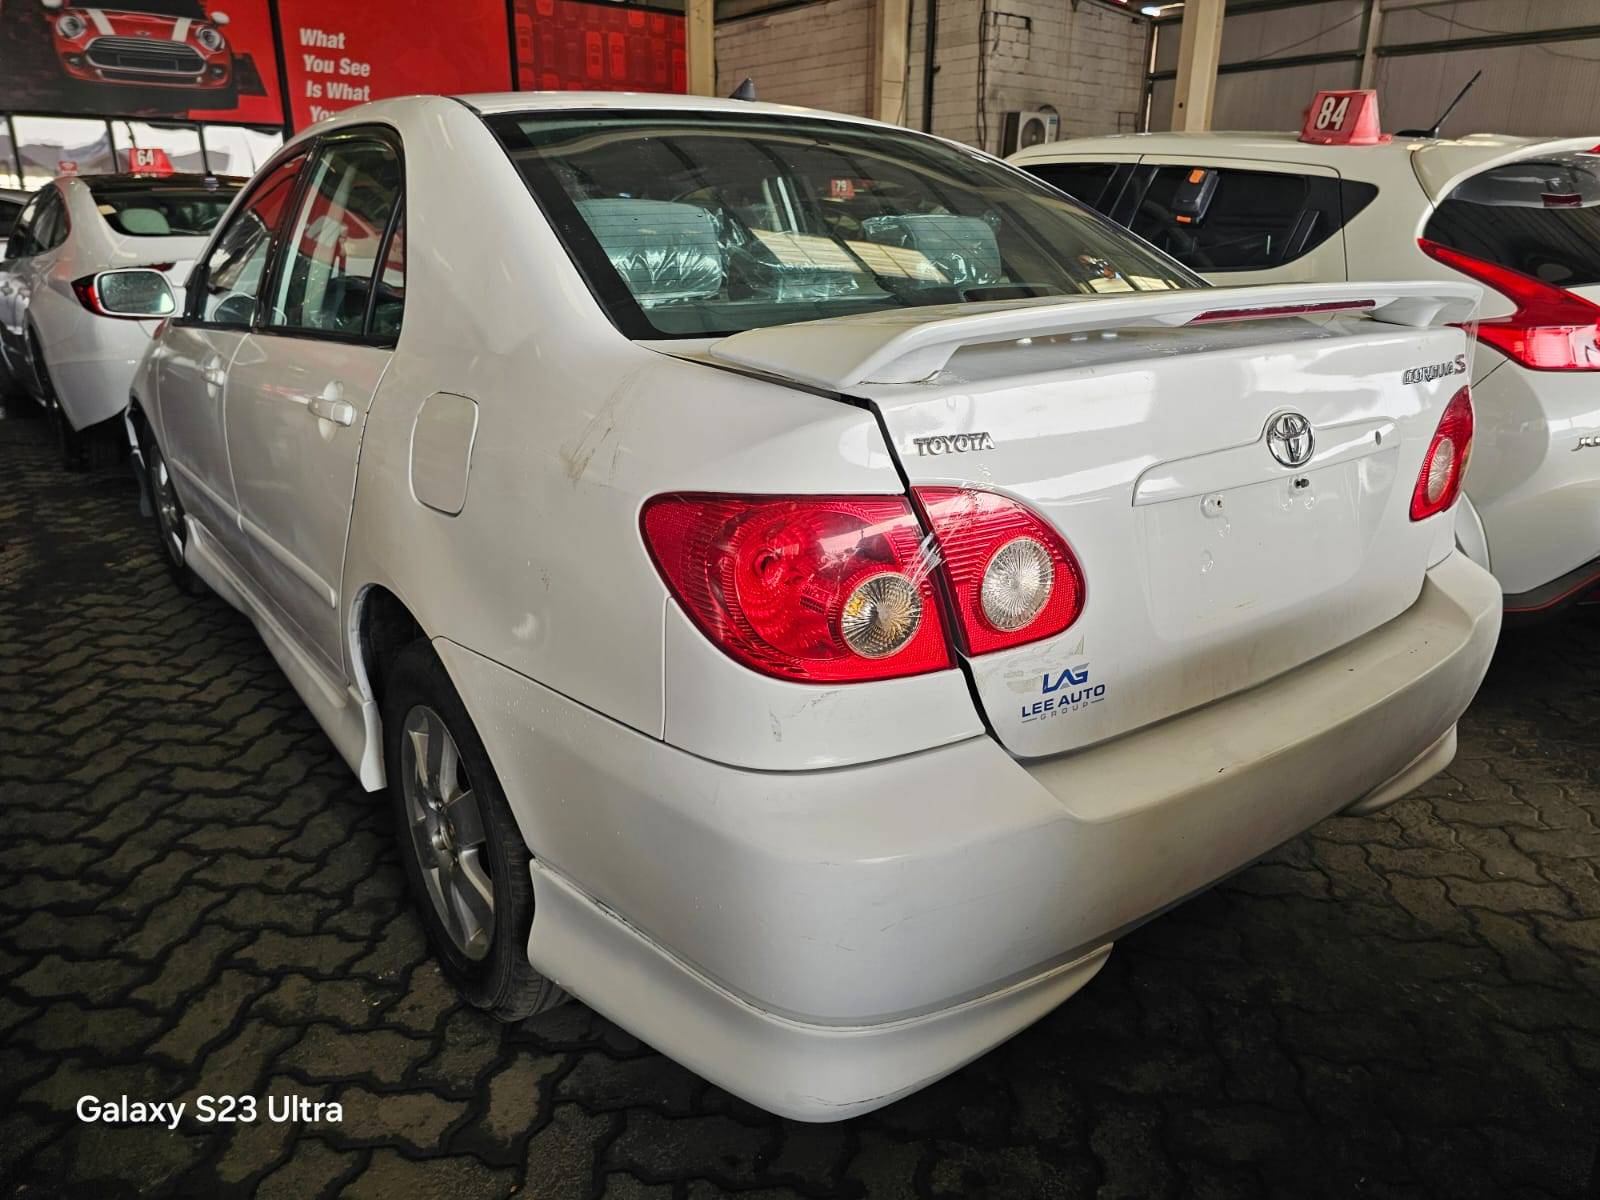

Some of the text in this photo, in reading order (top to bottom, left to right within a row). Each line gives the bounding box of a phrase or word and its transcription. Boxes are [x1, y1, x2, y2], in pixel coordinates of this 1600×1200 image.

[299, 27, 346, 50] What
[303, 54, 371, 77] You See
[306, 80, 370, 102] Is What
[1316, 96, 1351, 131] 84
[137, 149, 155, 167] 64
[912, 431, 995, 457] TOYOTA
[1042, 662, 1090, 695] LAG
[1021, 683, 1106, 718] LEE AUTO
[1040, 701, 1089, 720] GROUP
